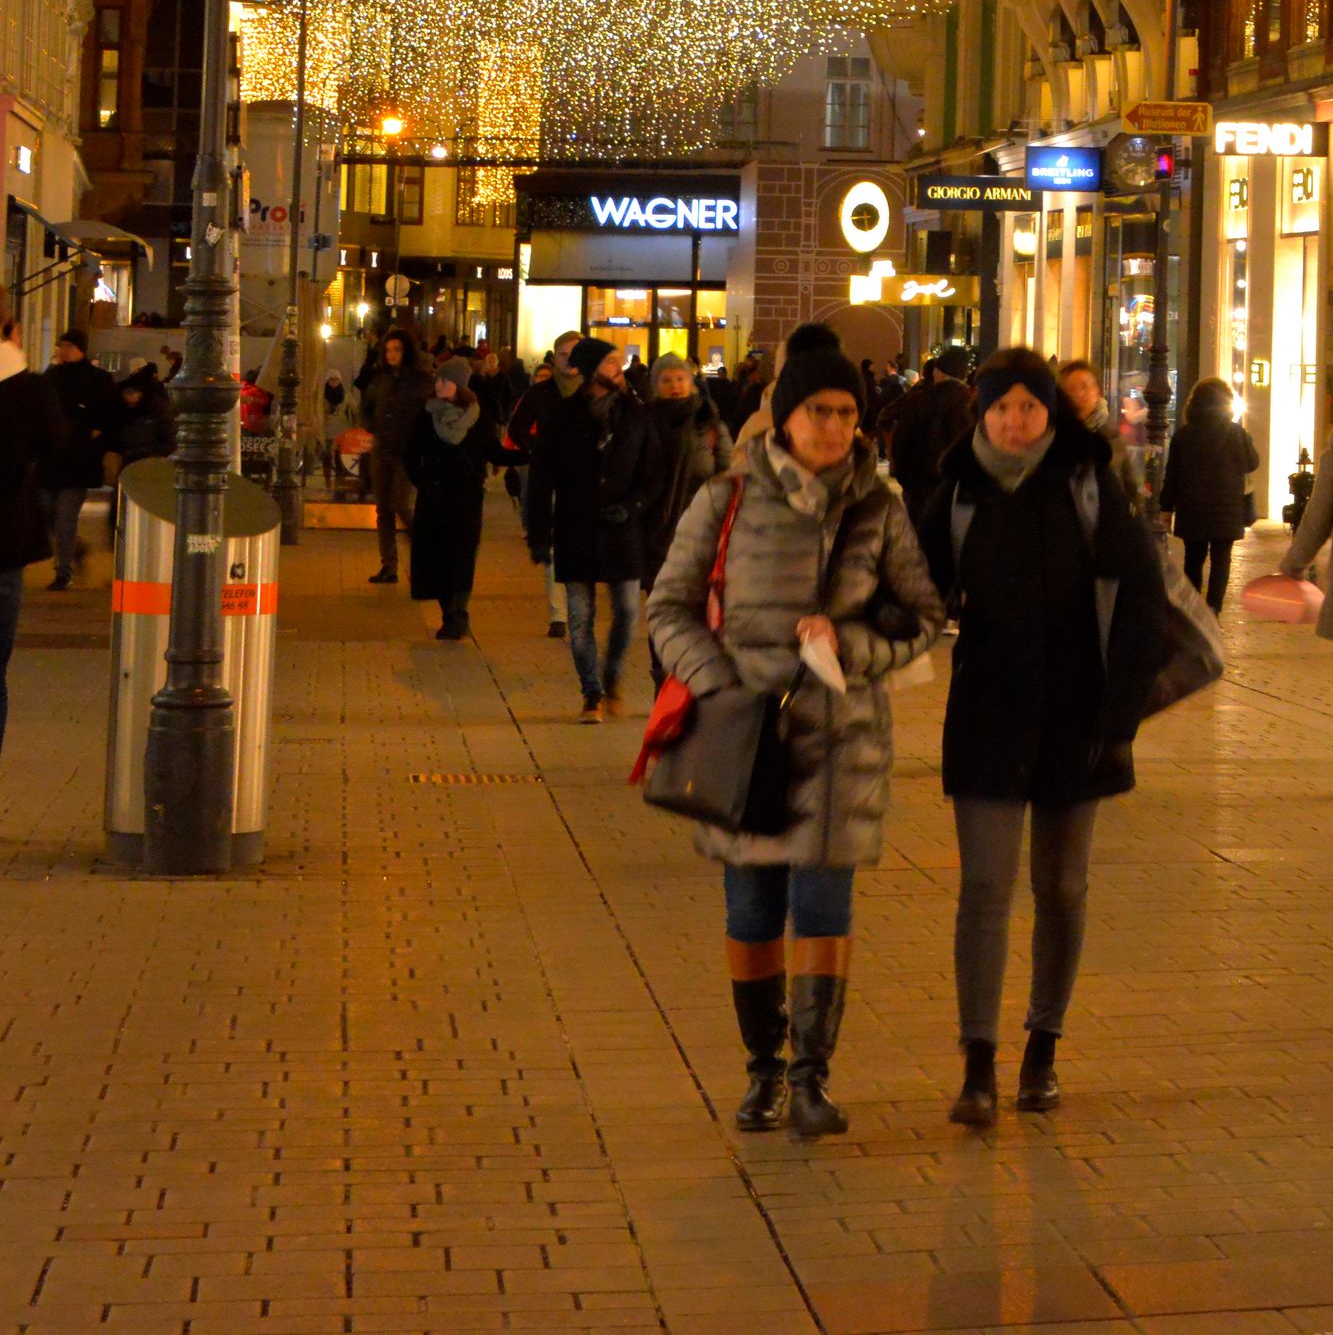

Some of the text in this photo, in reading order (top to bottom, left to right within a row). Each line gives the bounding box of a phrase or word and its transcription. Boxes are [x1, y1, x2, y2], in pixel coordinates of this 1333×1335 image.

[1214, 121, 1313, 155] FENDI
[1031, 167, 1094, 178] BREITLING
[927, 185, 1032, 202] GIORGIO ARMANI
[590, 196, 738, 230] WAGNER
